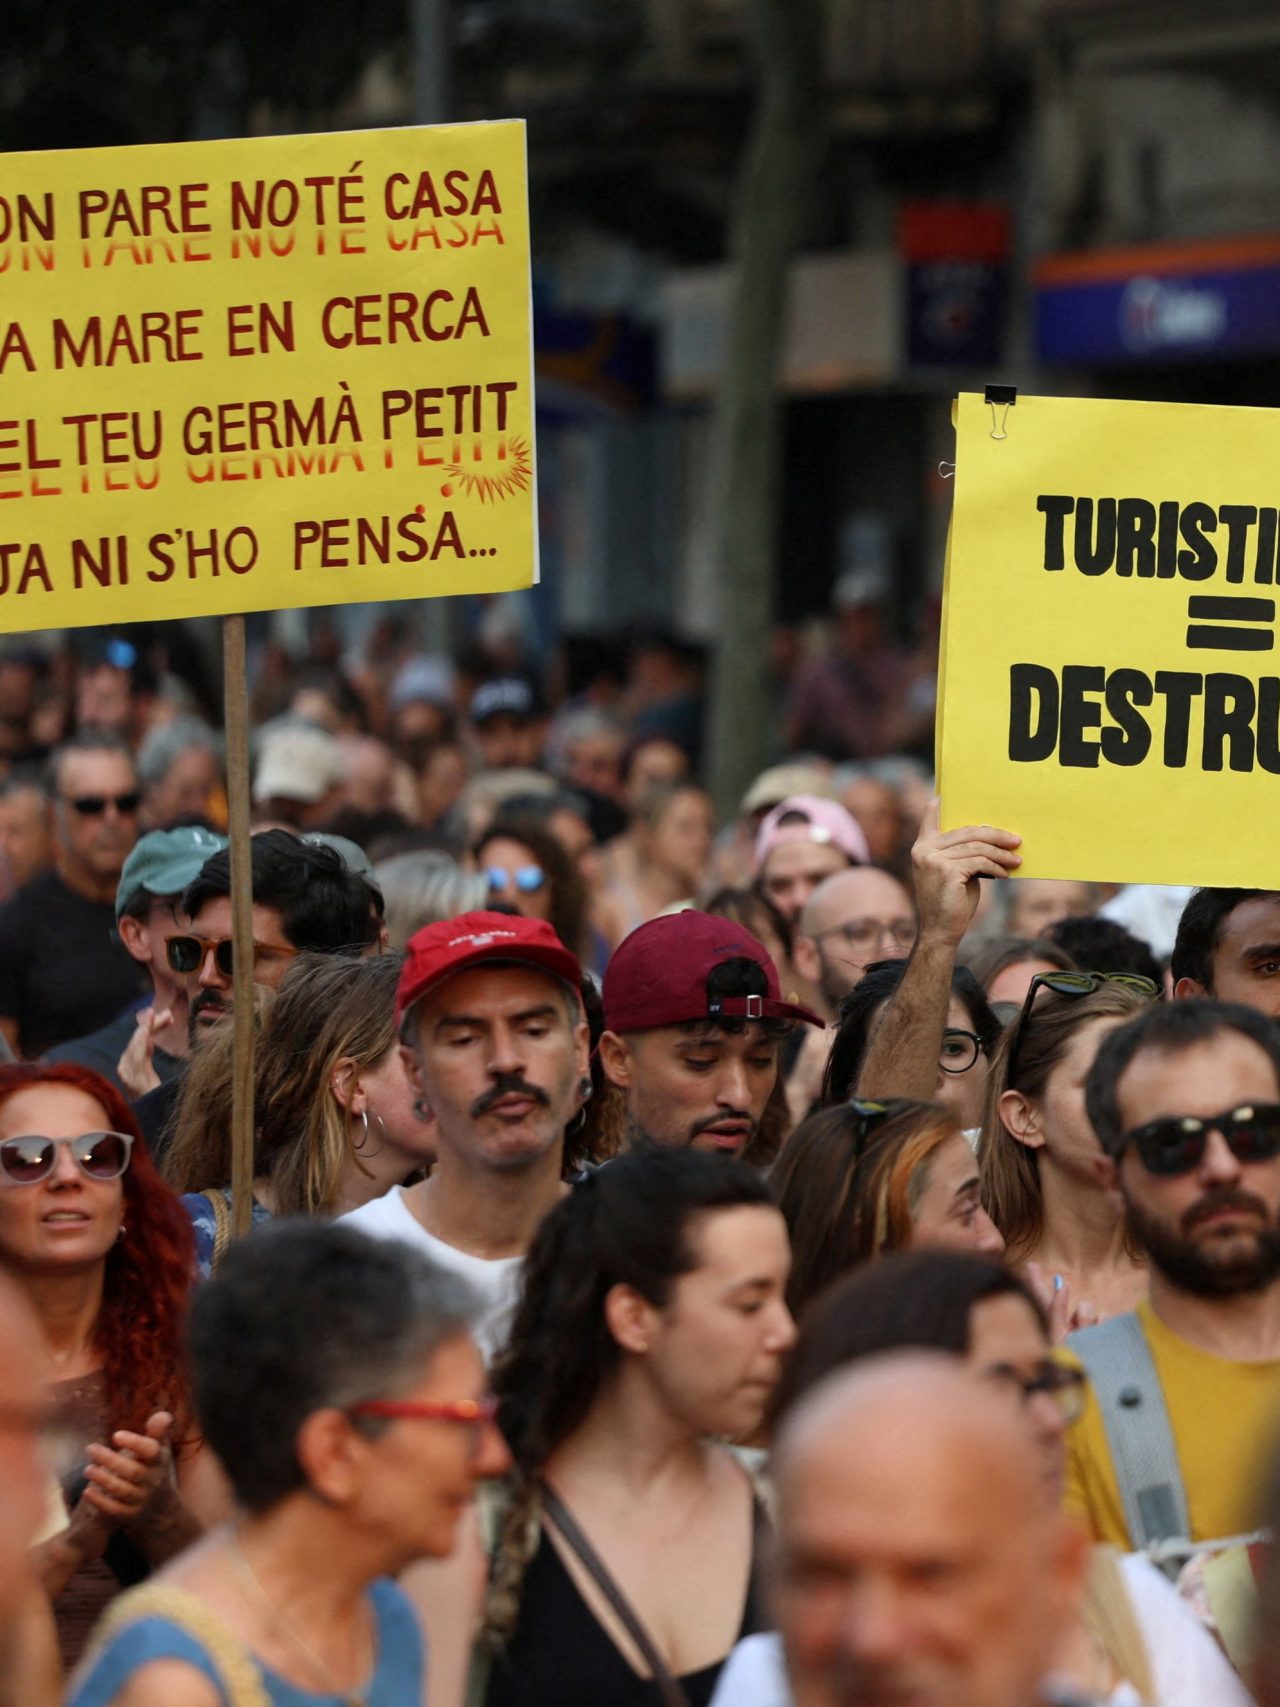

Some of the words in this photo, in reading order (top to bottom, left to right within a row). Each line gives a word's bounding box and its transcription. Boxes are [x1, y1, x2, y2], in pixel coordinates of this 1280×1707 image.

[80, 183, 211, 240] PARE
[384, 169, 502, 220] CASA
[53, 309, 203, 369] MARE
[227, 300, 295, 357] EN
[321, 286, 490, 349] CERCA
[182, 381, 363, 455] GERMÀ
[382, 381, 518, 440] PETIT
[72, 534, 129, 589] NI
[147, 527, 259, 582] S'HO
[294, 511, 498, 571] PENSA...
